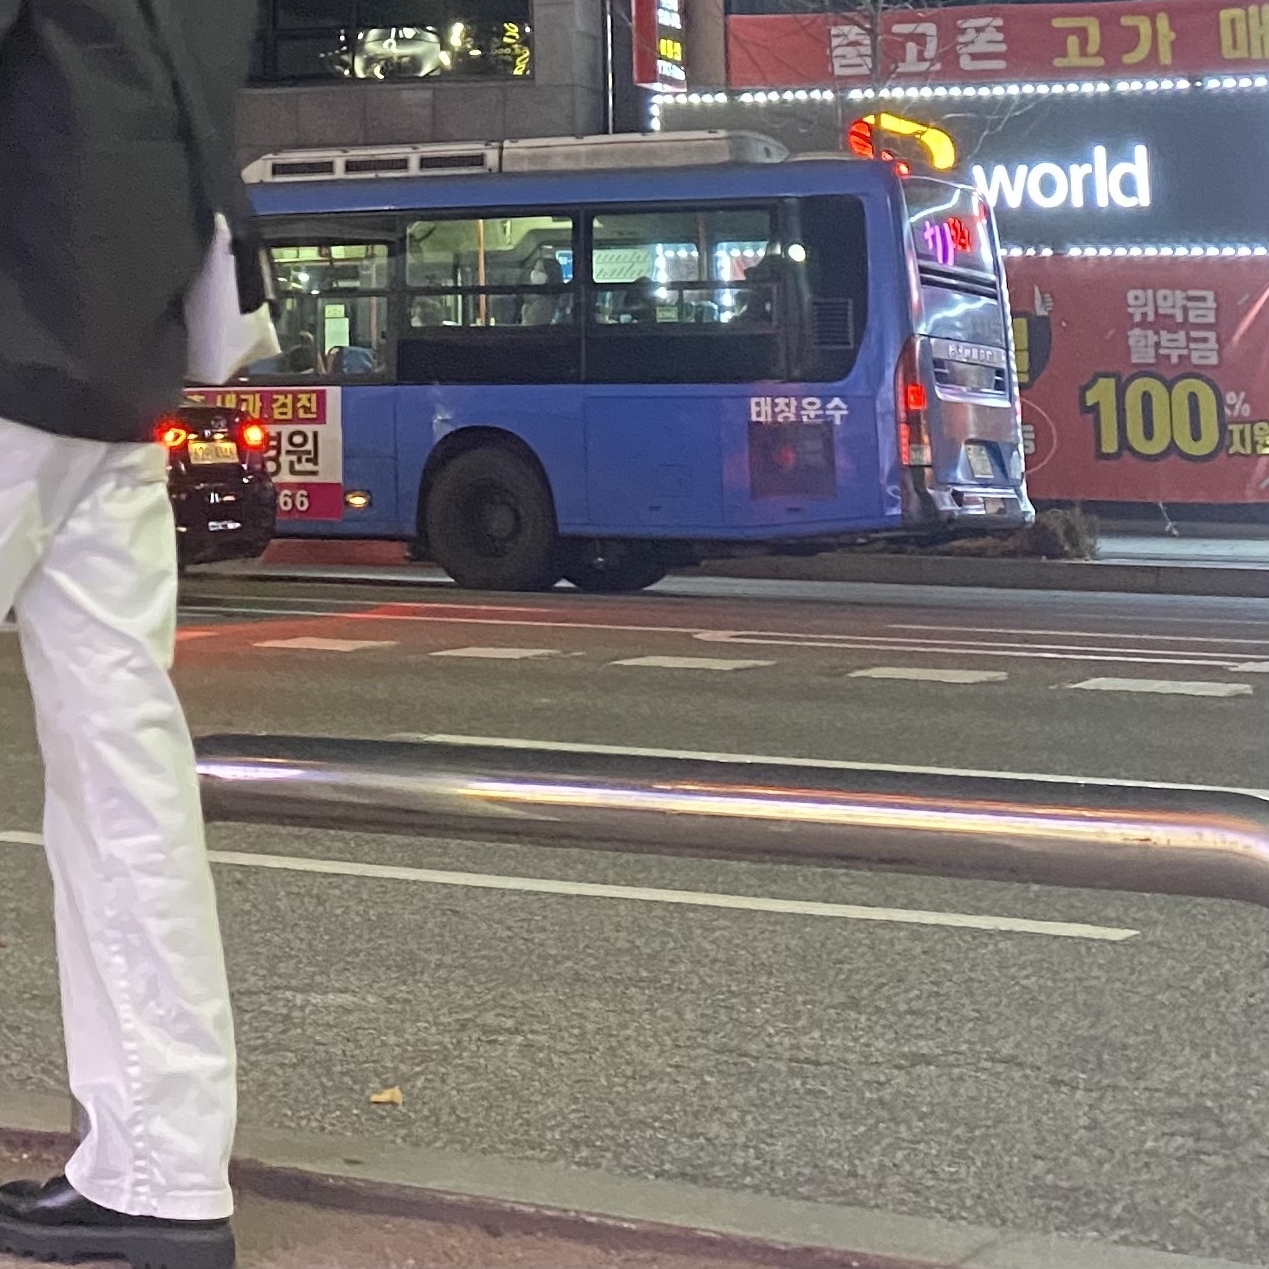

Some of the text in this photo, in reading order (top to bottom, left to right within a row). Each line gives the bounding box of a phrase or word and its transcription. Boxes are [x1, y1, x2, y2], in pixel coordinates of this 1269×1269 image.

[1051, 12, 1177, 69] 고가
[972, 144, 1151, 208] world
[1126, 288, 1217, 324] 위약금
[1127, 328, 1219, 365] 할부금
